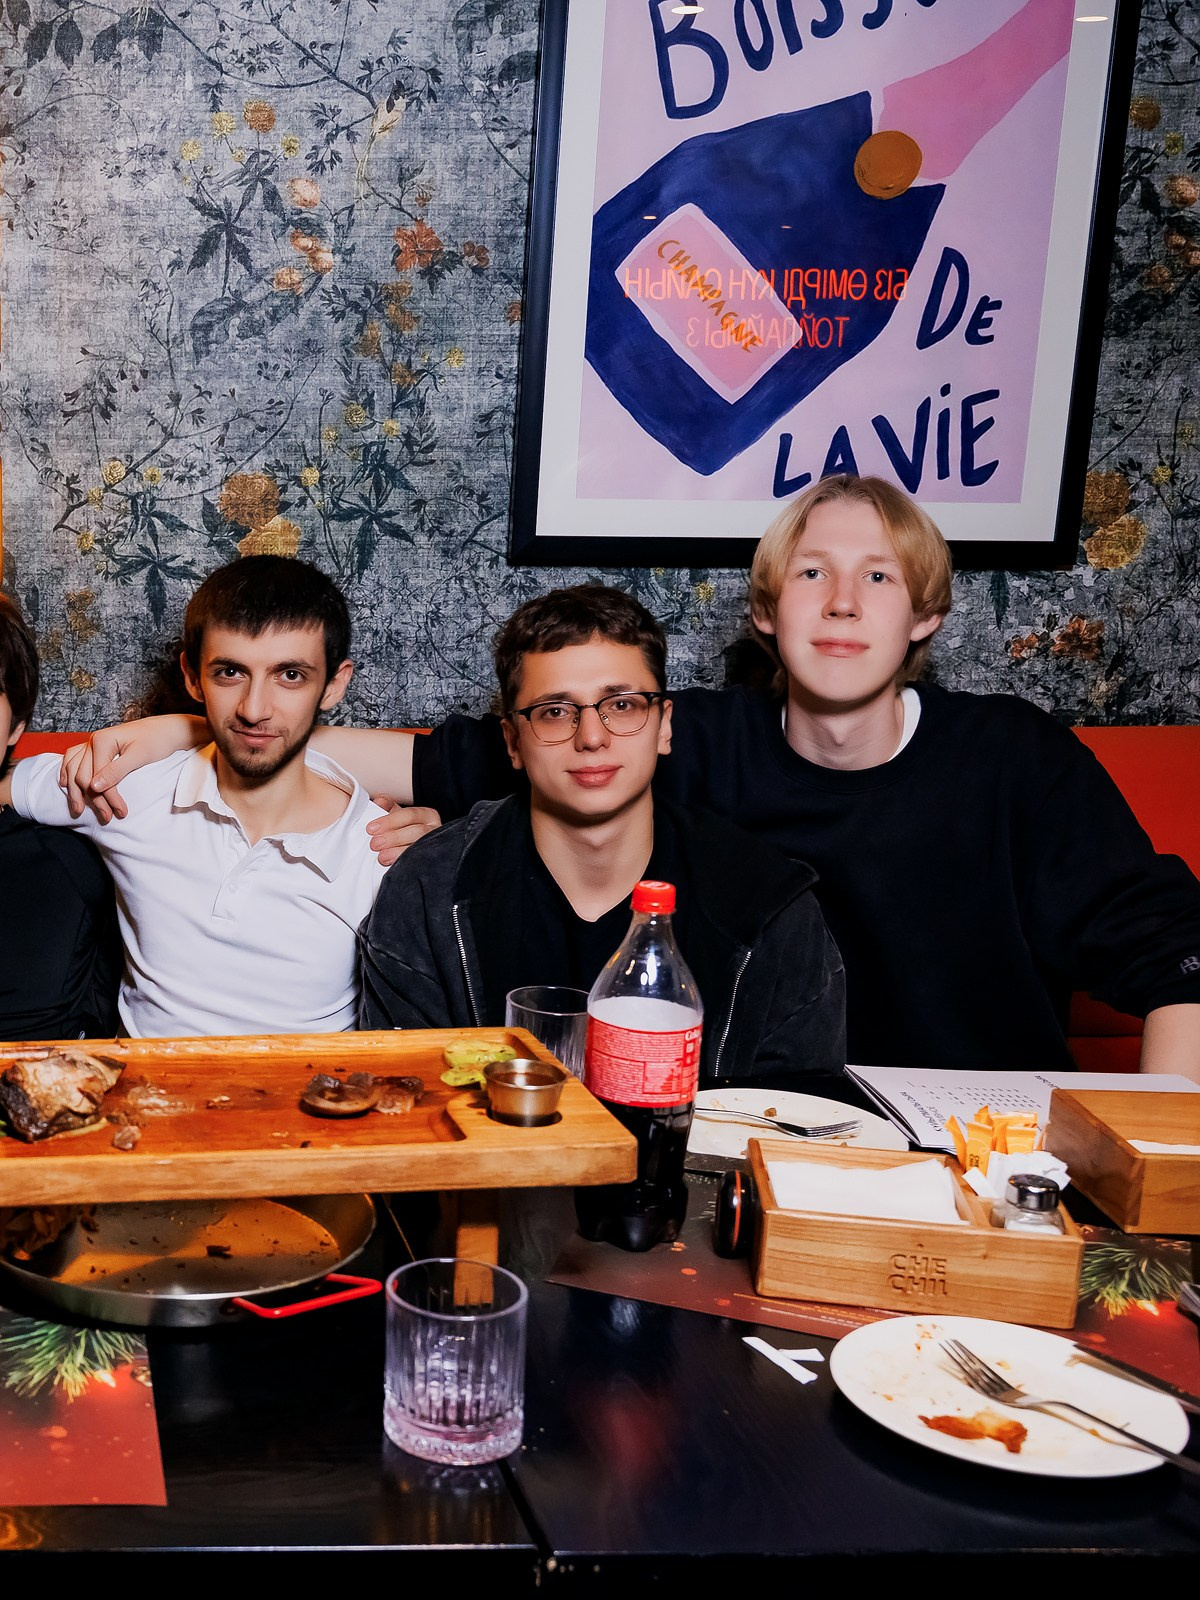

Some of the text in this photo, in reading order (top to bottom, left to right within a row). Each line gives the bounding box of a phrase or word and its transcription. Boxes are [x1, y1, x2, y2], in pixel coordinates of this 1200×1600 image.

[657, 239, 764, 353] CHAMPAGNE
[772, 424, 861, 499] LA
[888, 1253, 947, 1276] CHE
